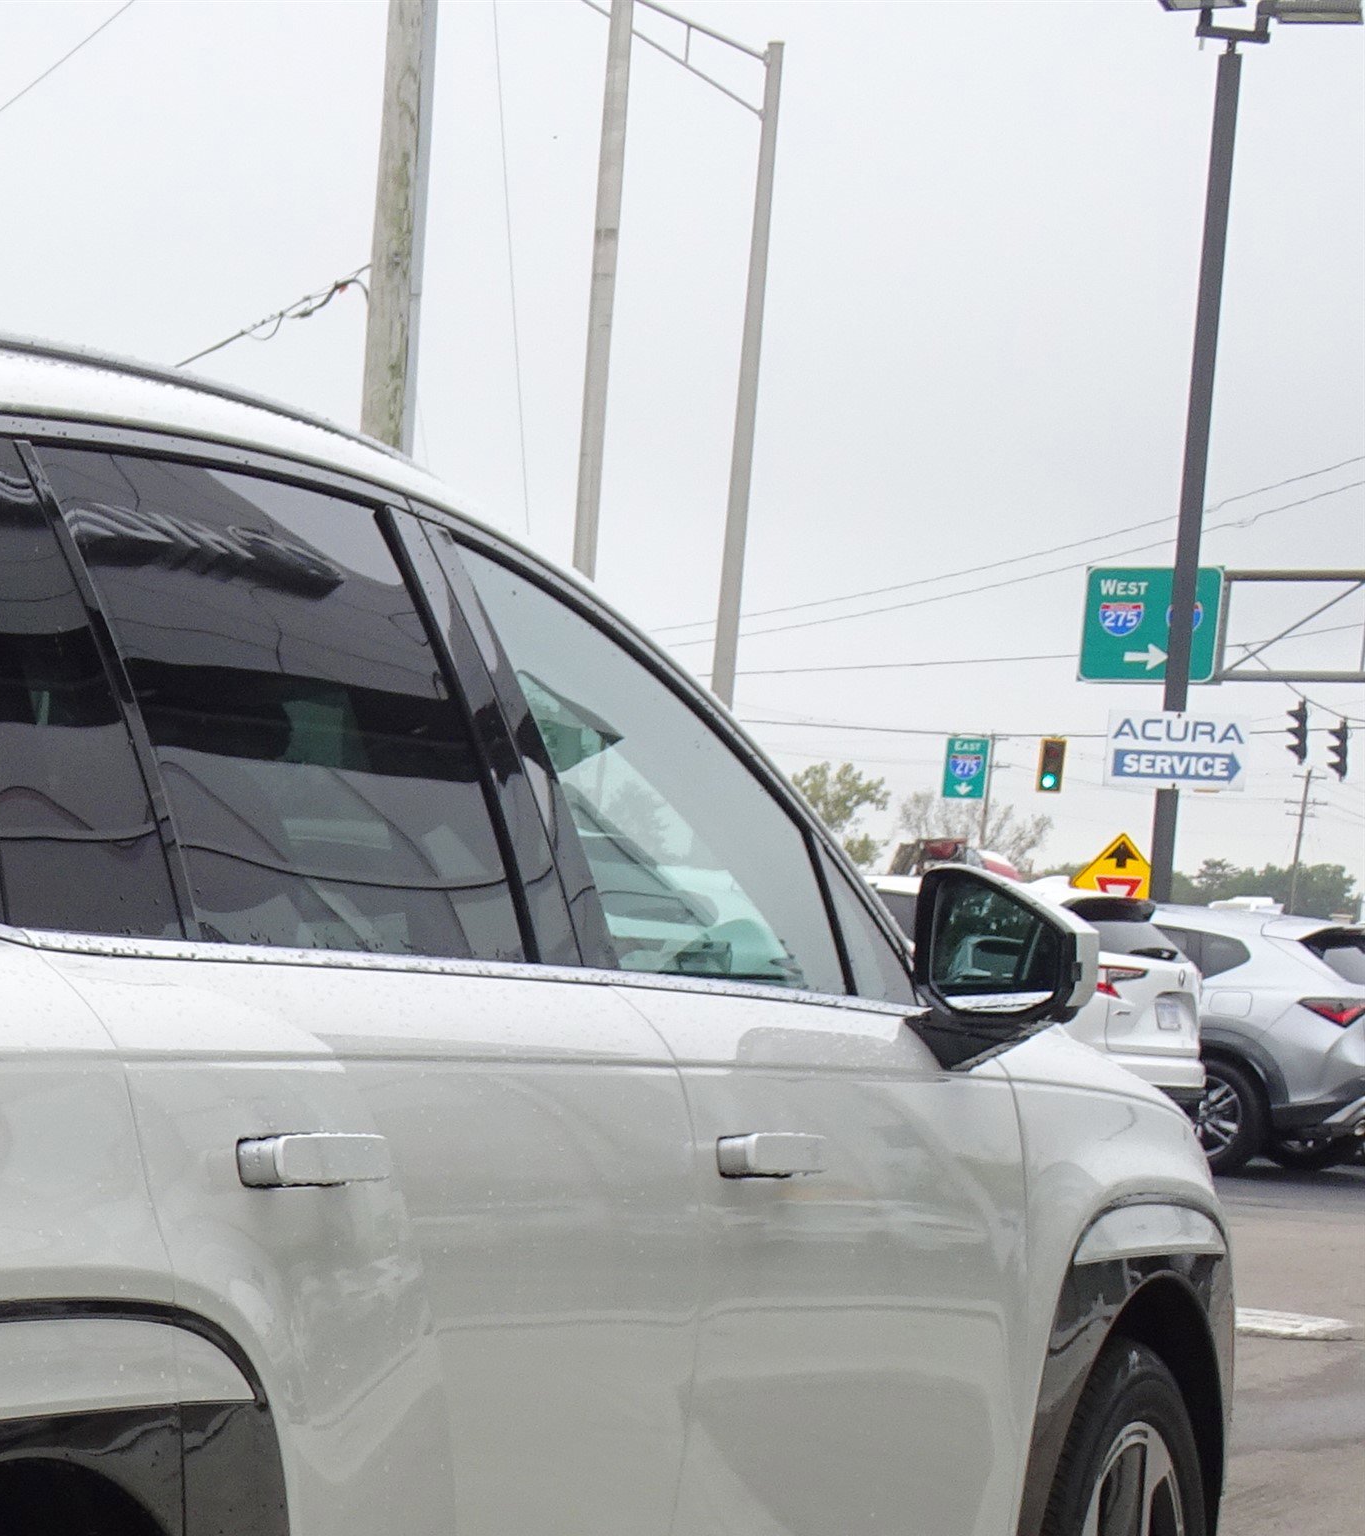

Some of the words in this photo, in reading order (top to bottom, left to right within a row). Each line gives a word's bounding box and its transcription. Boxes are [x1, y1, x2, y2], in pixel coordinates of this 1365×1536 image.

[1100, 579, 1149, 596] WEST
[1103, 611, 1138, 627] 275
[1112, 718, 1245, 744] ACURA
[953, 740, 981, 752] EAST
[955, 760, 978, 775] 275
[1122, 753, 1230, 777] SERVICE
